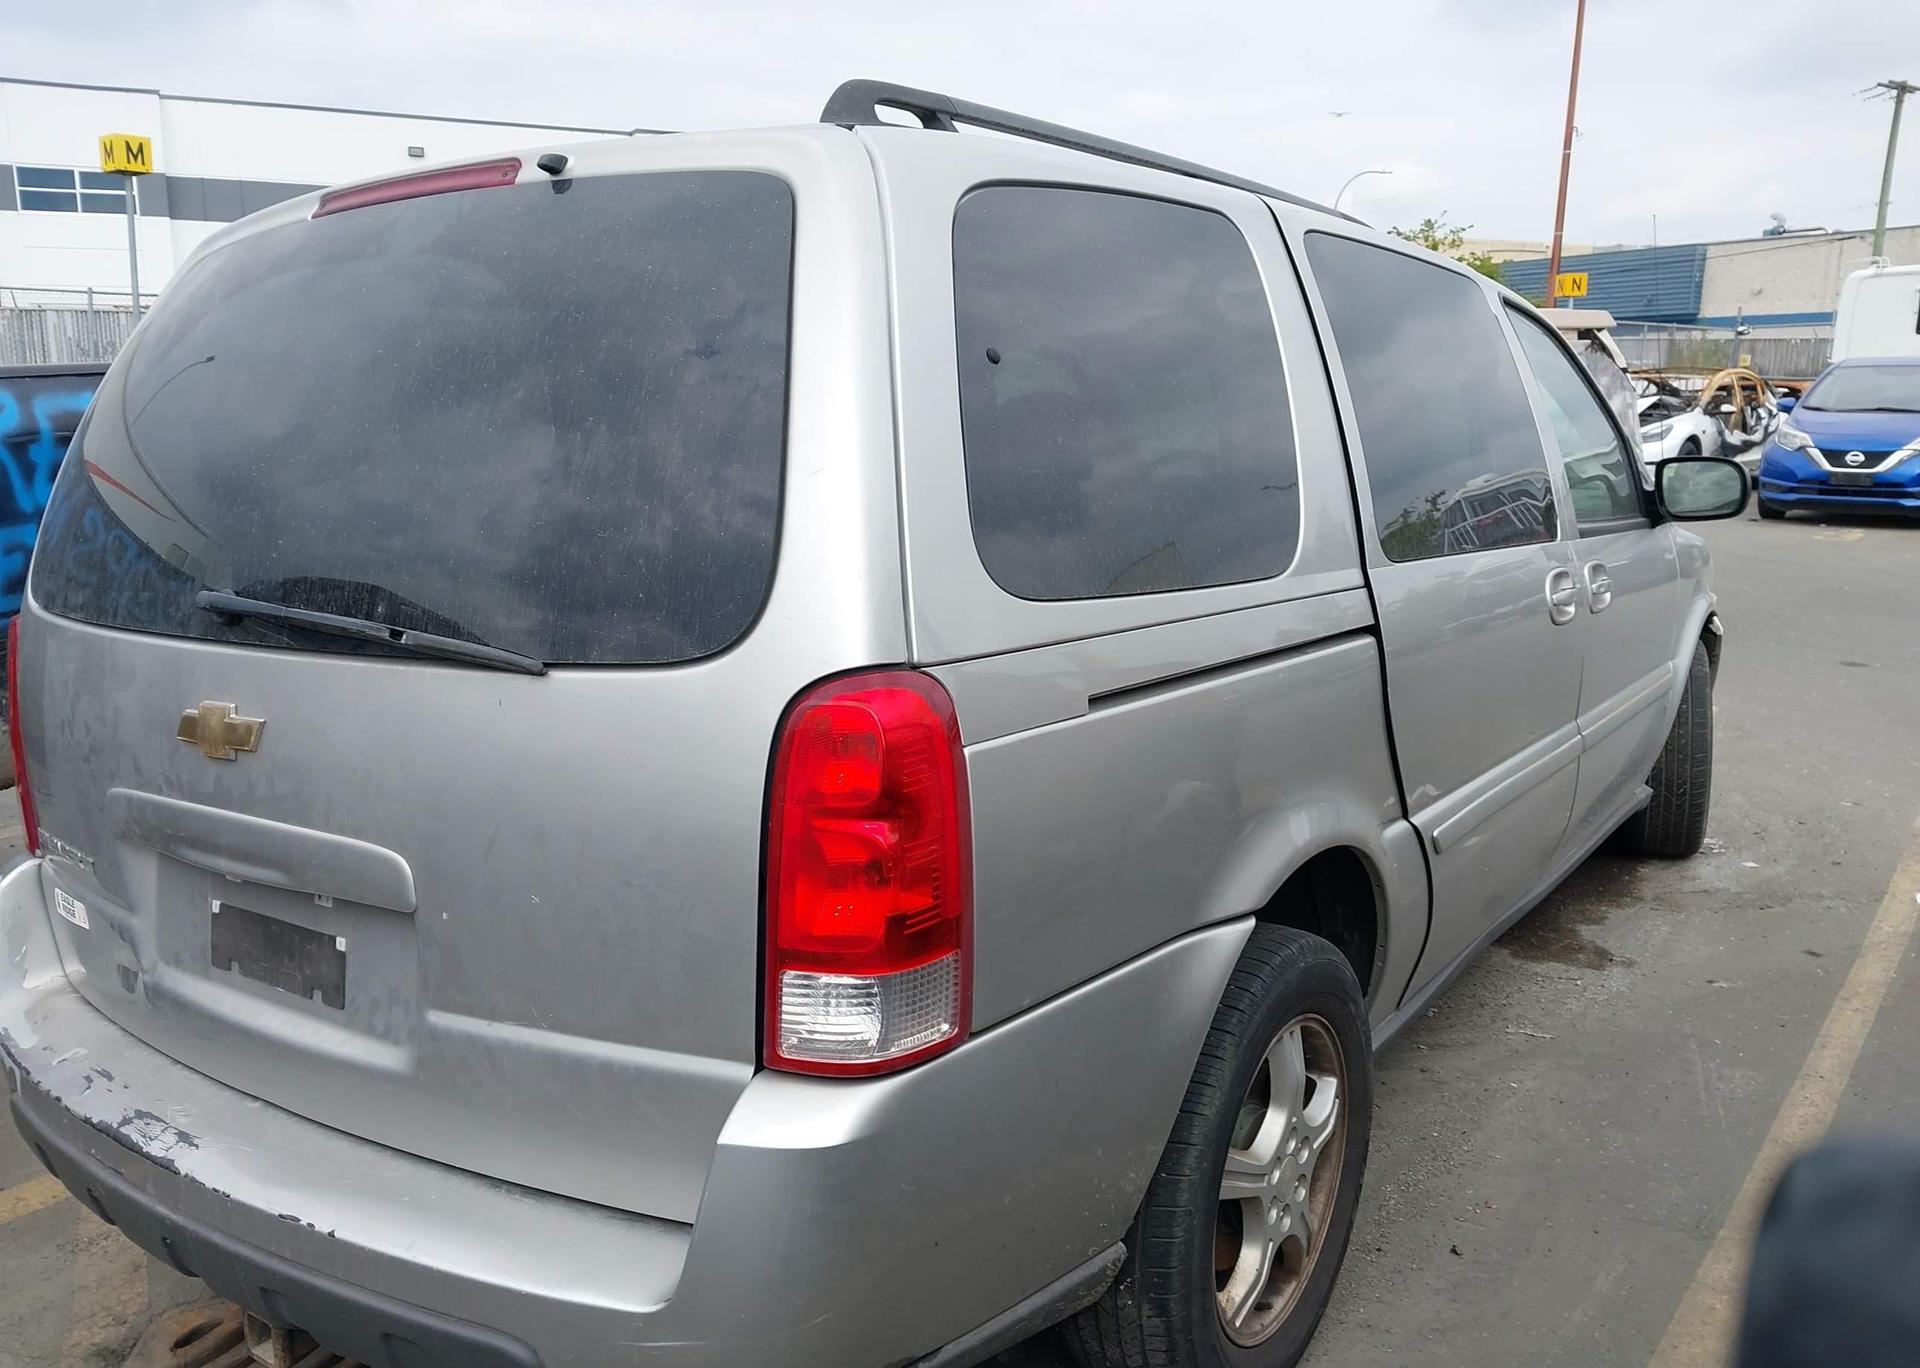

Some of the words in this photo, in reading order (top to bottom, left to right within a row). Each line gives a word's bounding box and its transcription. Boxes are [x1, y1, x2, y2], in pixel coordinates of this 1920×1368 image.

[103, 139, 115, 165] M
[125, 140, 145, 167] M
[1557, 278, 1564, 294] N
[1571, 276, 1582, 293] N
